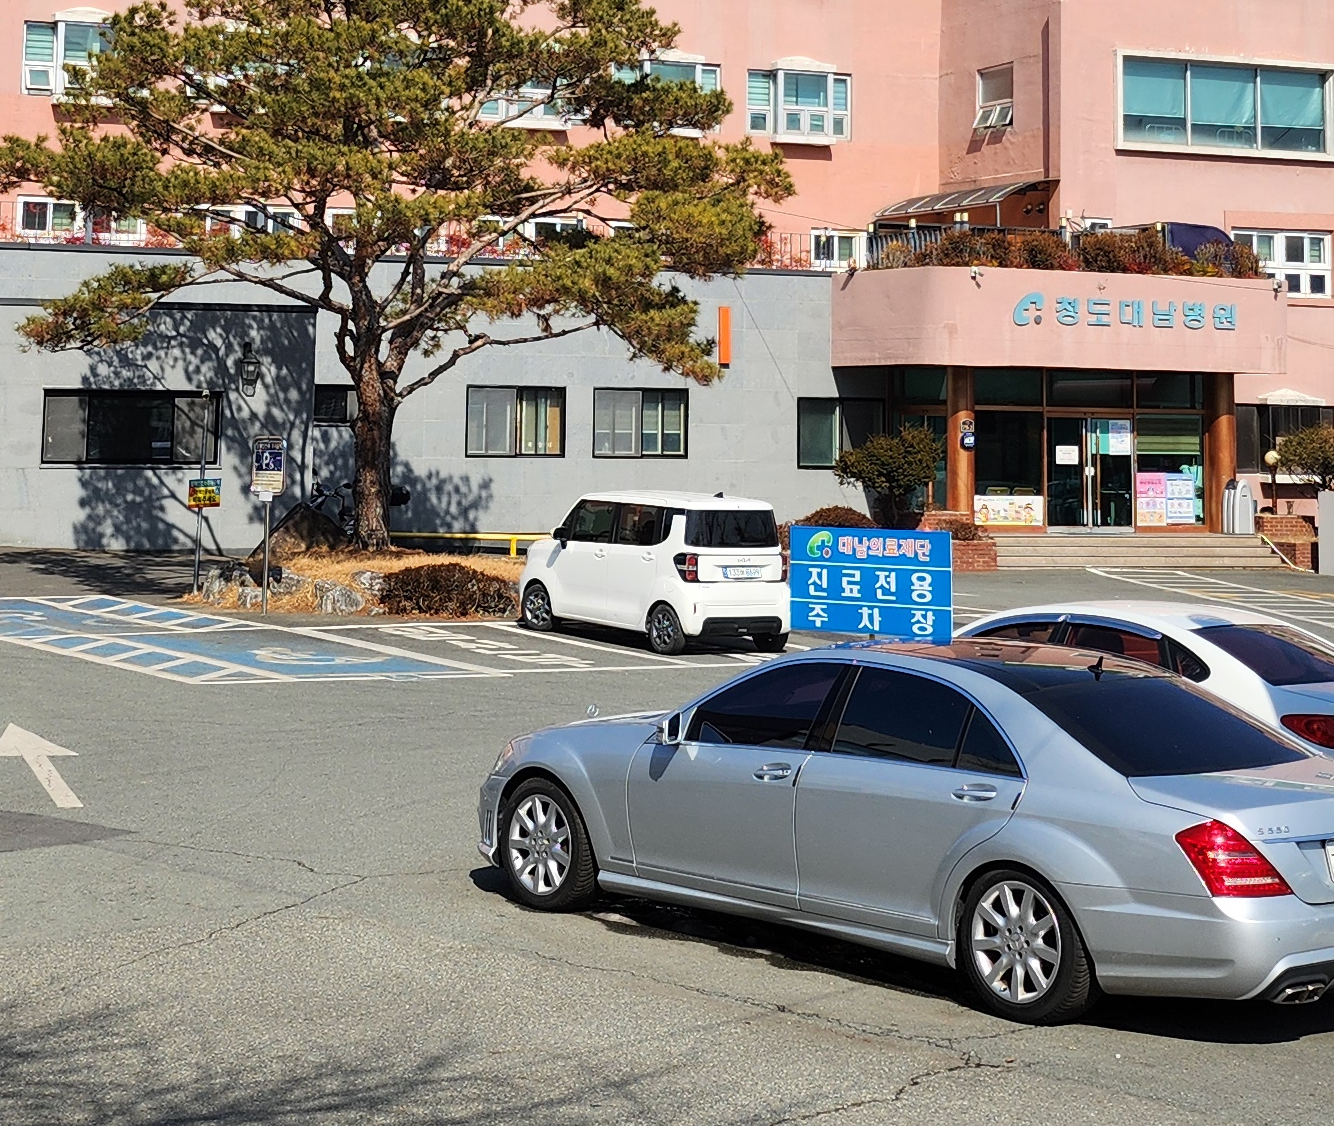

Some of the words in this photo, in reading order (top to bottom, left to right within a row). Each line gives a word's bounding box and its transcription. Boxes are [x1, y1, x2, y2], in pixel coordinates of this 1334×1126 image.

[1055, 295, 1238, 331] 청도대남병원
[838, 536, 931, 561] 대남의료재단
[807, 567, 934, 603] 진료전용
[807, 605, 935, 635] 주차장
